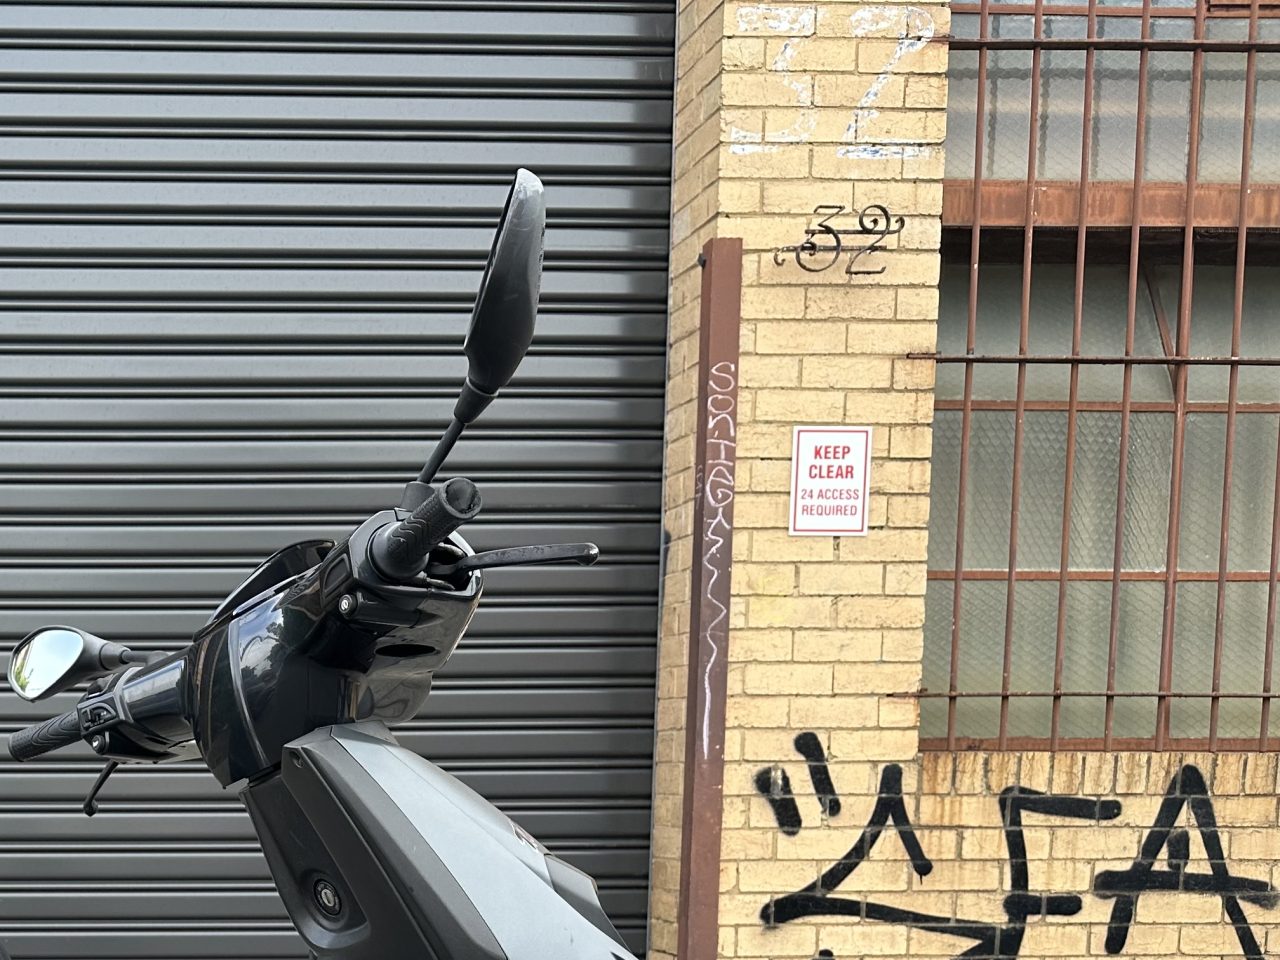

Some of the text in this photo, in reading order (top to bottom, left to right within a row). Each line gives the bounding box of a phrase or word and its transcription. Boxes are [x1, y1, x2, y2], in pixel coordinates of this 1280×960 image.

[730, 6, 935, 160] 32
[794, 204, 893, 275] 32
[814, 445, 851, 460] KEEP
[808, 464, 854, 479] CLEAR
[801, 488, 860, 500] 24 ACCESS
[801, 504, 858, 516] REQUIRED
